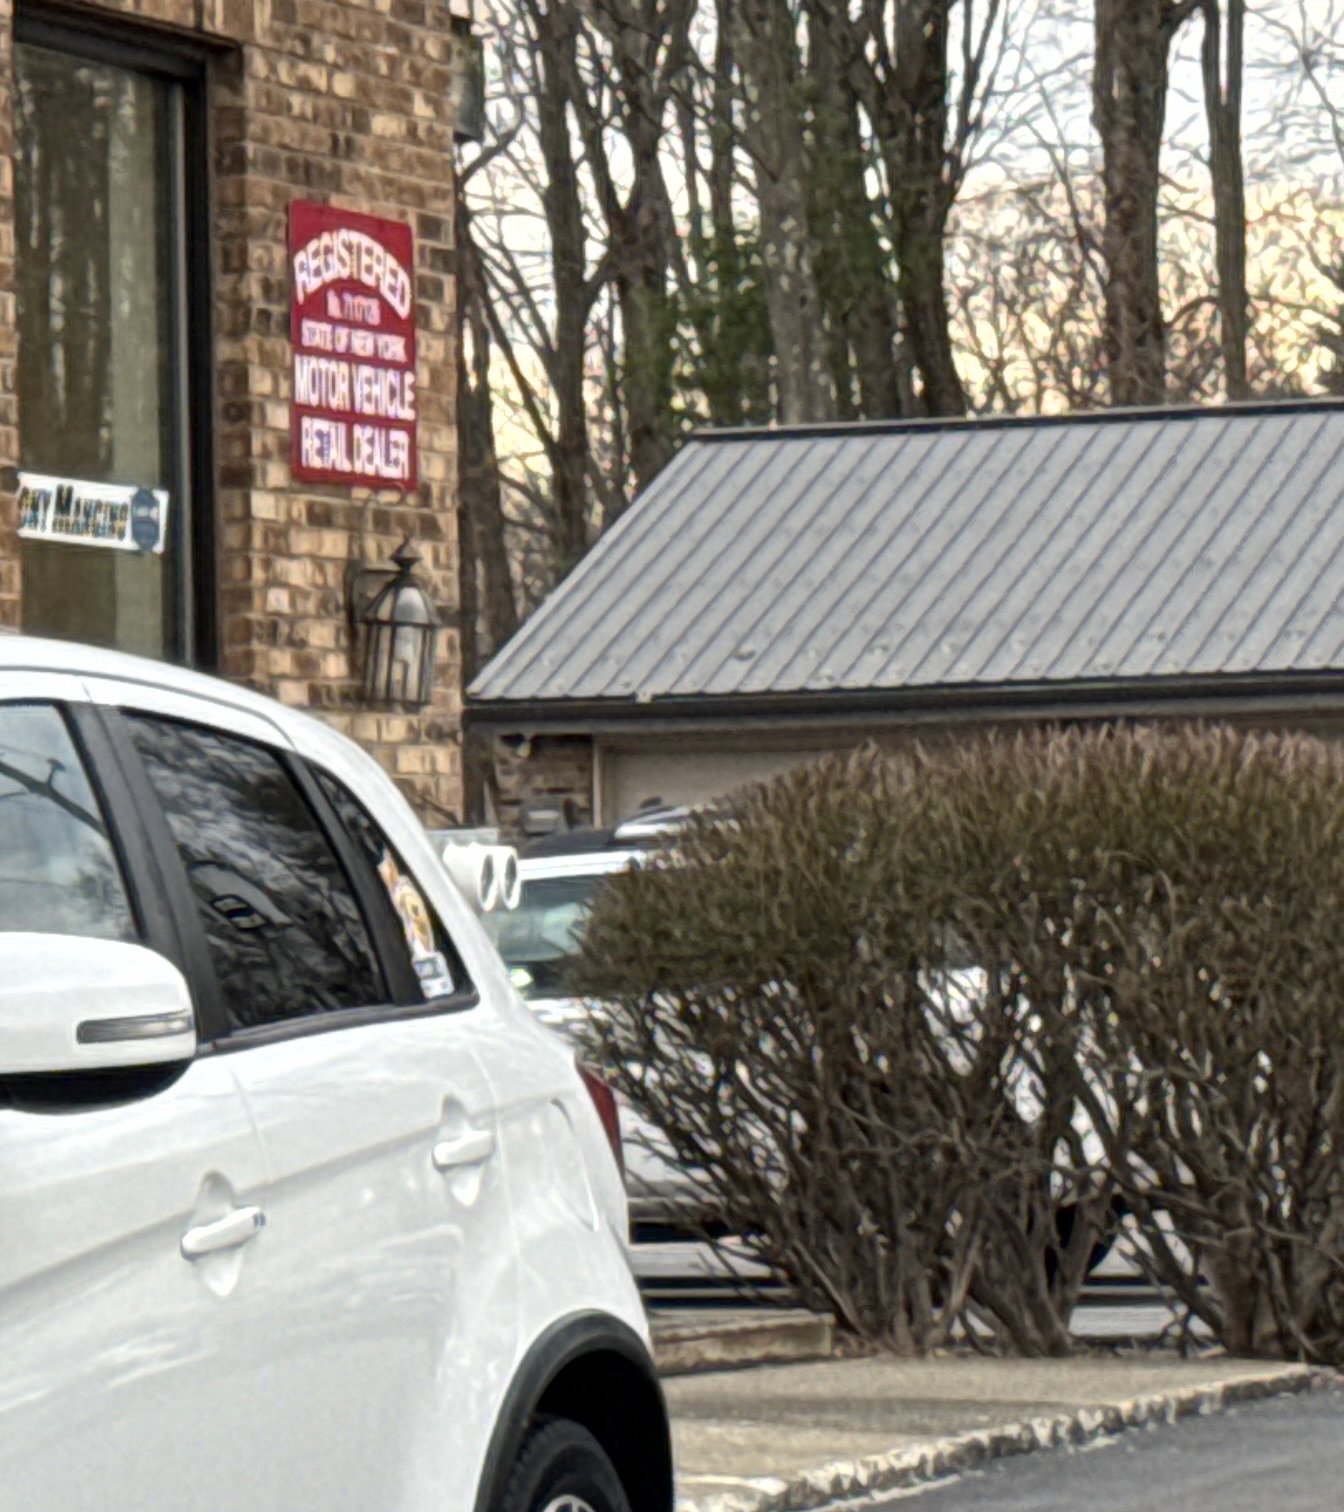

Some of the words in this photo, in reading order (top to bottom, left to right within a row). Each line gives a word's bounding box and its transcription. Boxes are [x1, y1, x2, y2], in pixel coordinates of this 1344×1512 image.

[293, 228, 411, 320] REGISTERED
[294, 353, 351, 412] MOTOR
[351, 362, 416, 421] VEHICLE
[301, 415, 353, 473] RETAIL
[352, 422, 411, 480] DEALER
